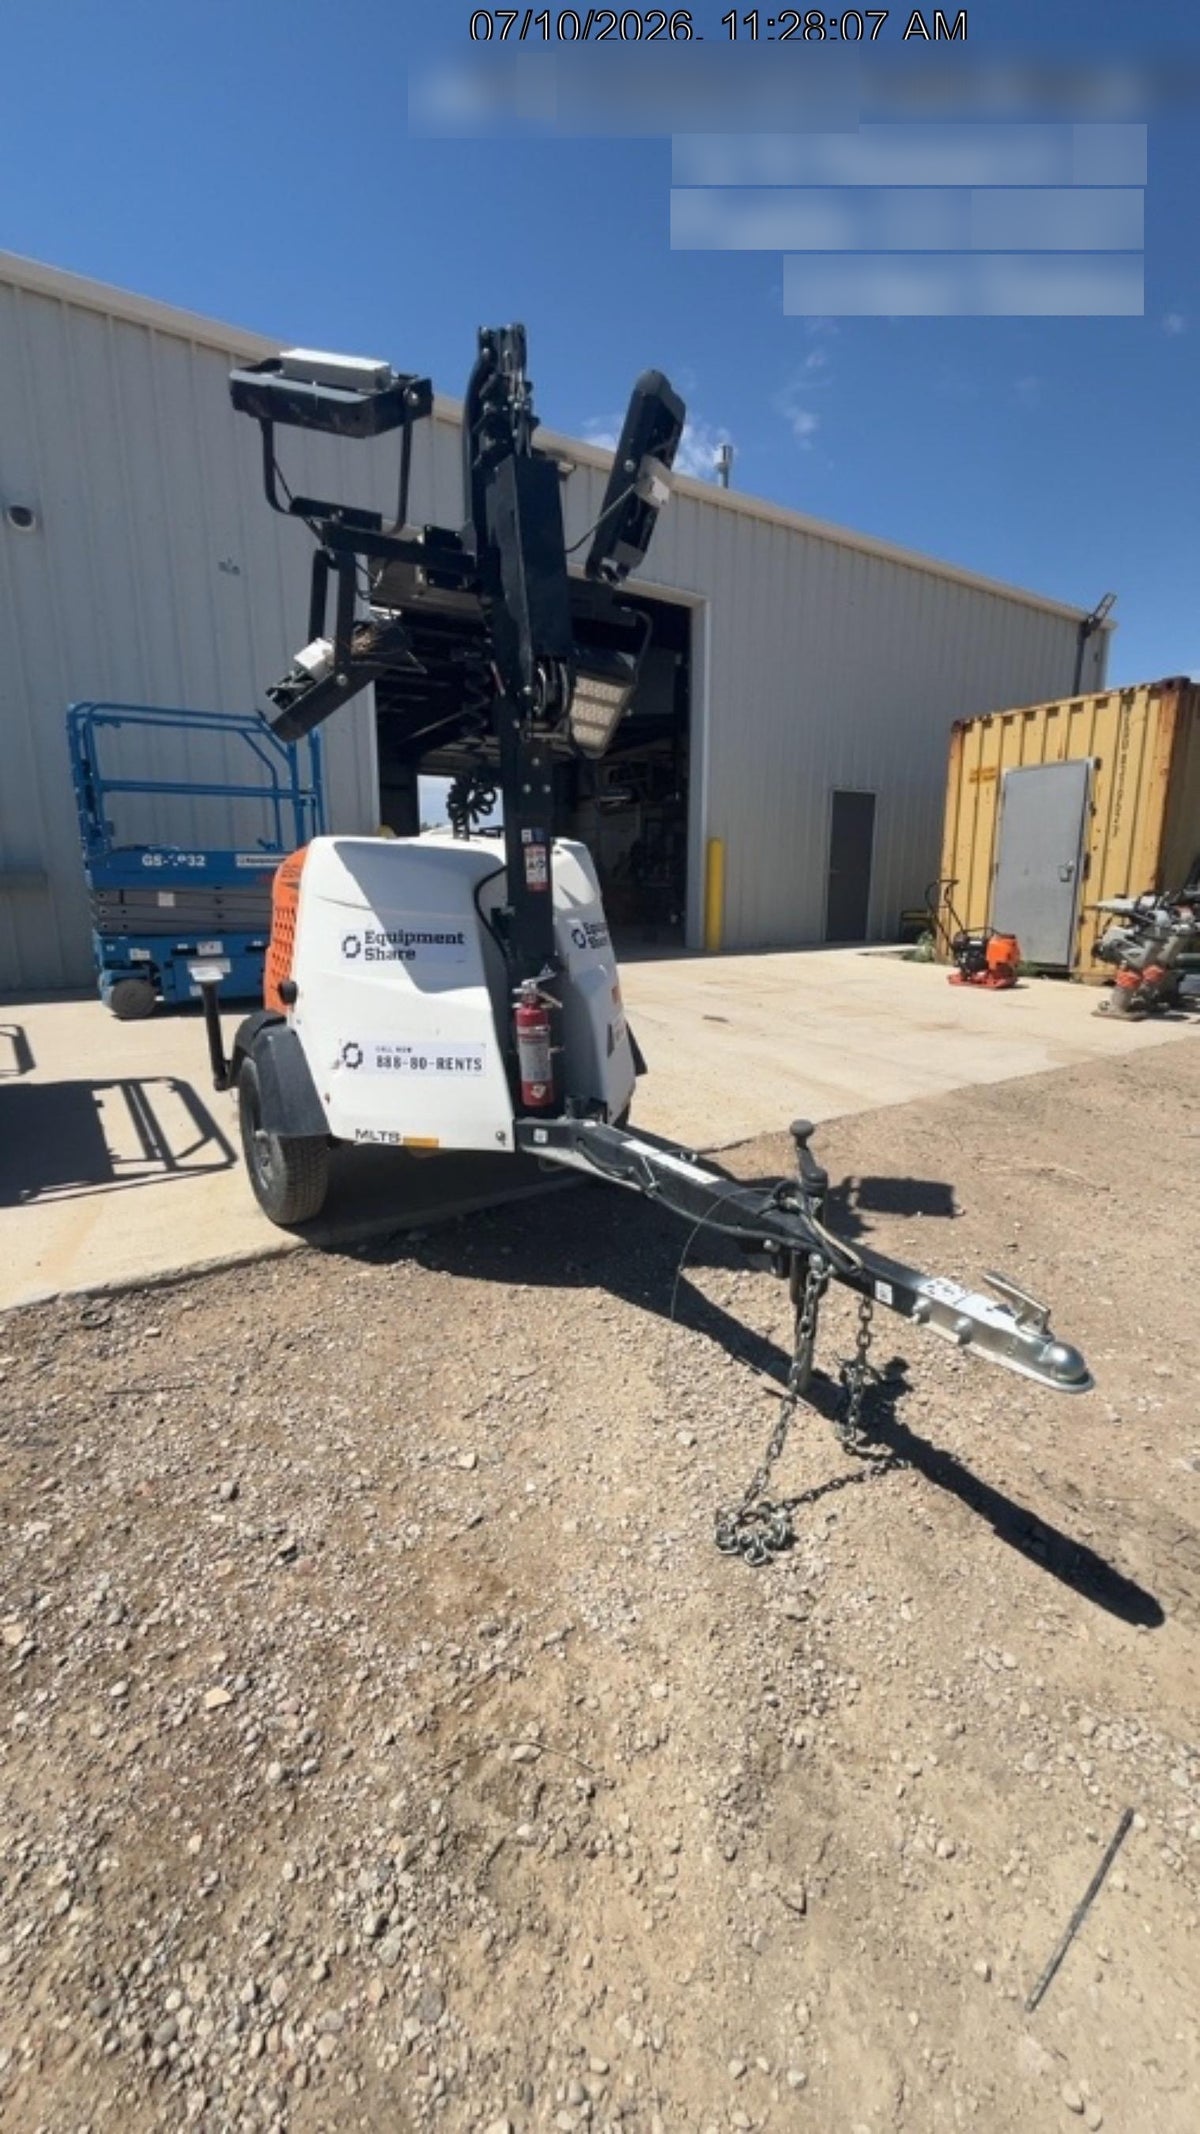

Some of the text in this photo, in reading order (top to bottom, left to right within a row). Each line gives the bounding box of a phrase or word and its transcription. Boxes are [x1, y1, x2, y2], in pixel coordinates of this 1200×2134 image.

[364, 929, 465, 947] Equipment
[364, 947, 416, 961] Share
[376, 1055, 482, 1070] 888-80-RENTS
